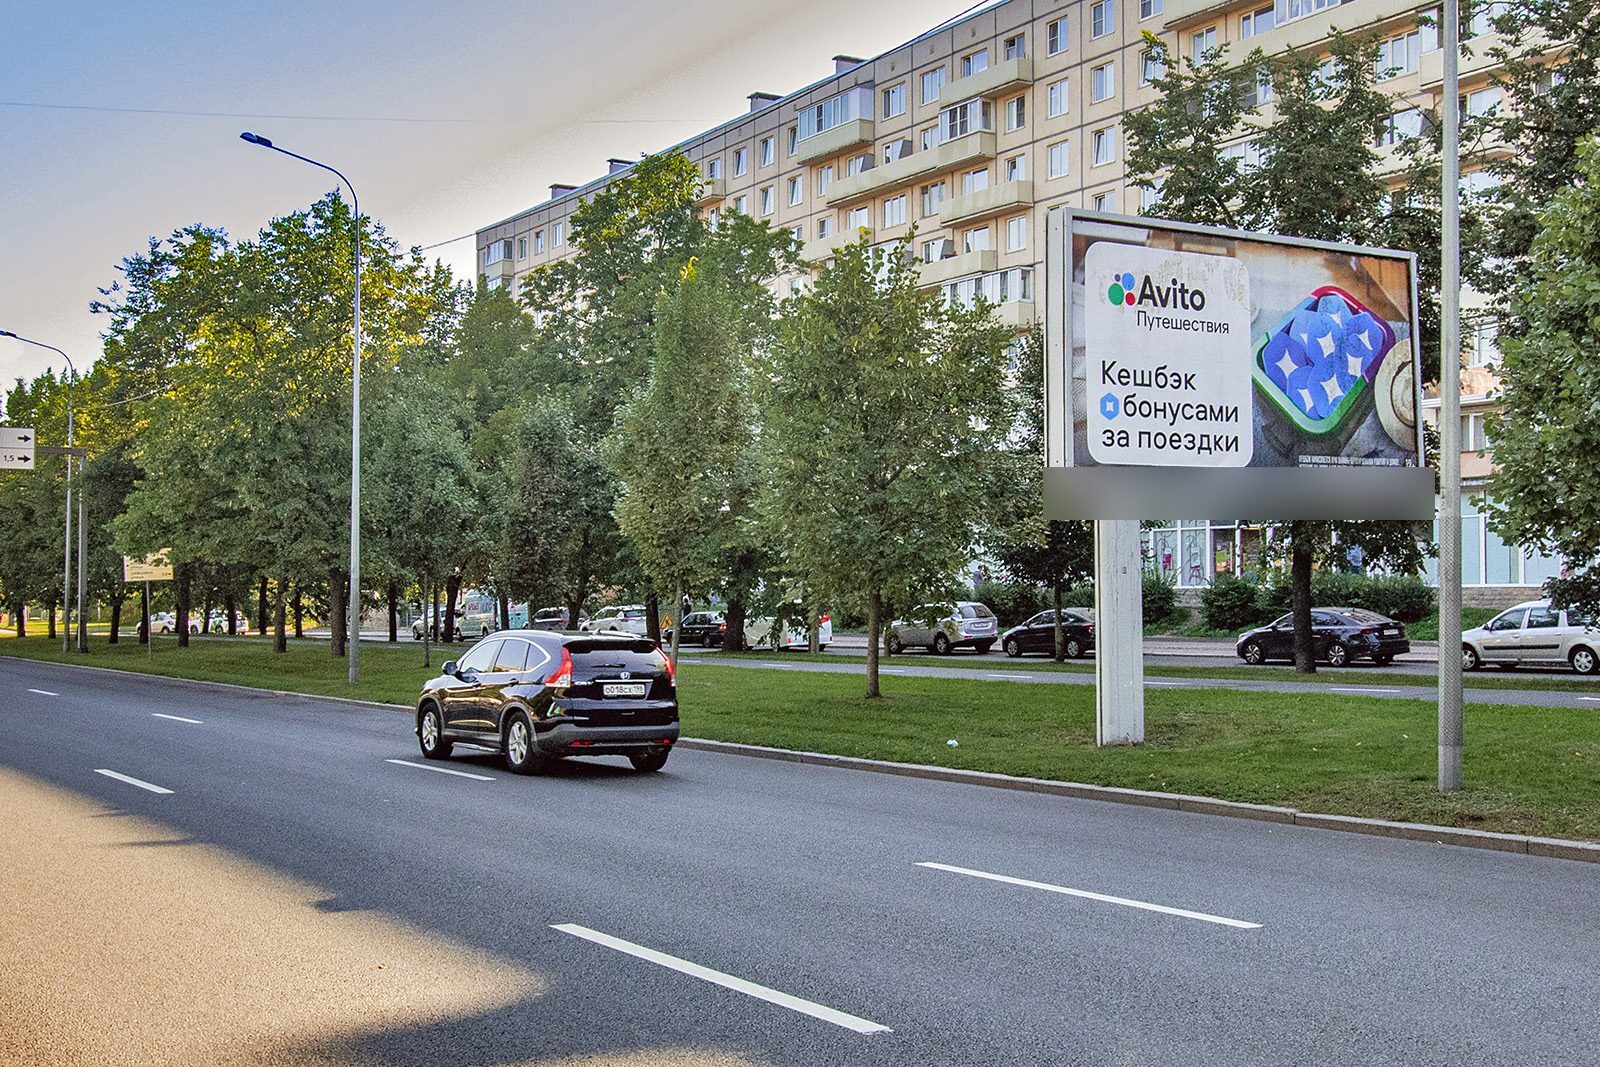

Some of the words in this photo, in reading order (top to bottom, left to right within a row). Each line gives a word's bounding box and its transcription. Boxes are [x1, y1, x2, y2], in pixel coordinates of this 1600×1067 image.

[1137, 275, 1206, 311] Avito
[1137, 310, 1230, 334] Путешествия
[1101, 360, 1197, 391] Кешбэк
[1123, 393, 1239, 426] бонусами
[1102, 429, 1130, 448] за
[1138, 431, 1239, 455] поездки
